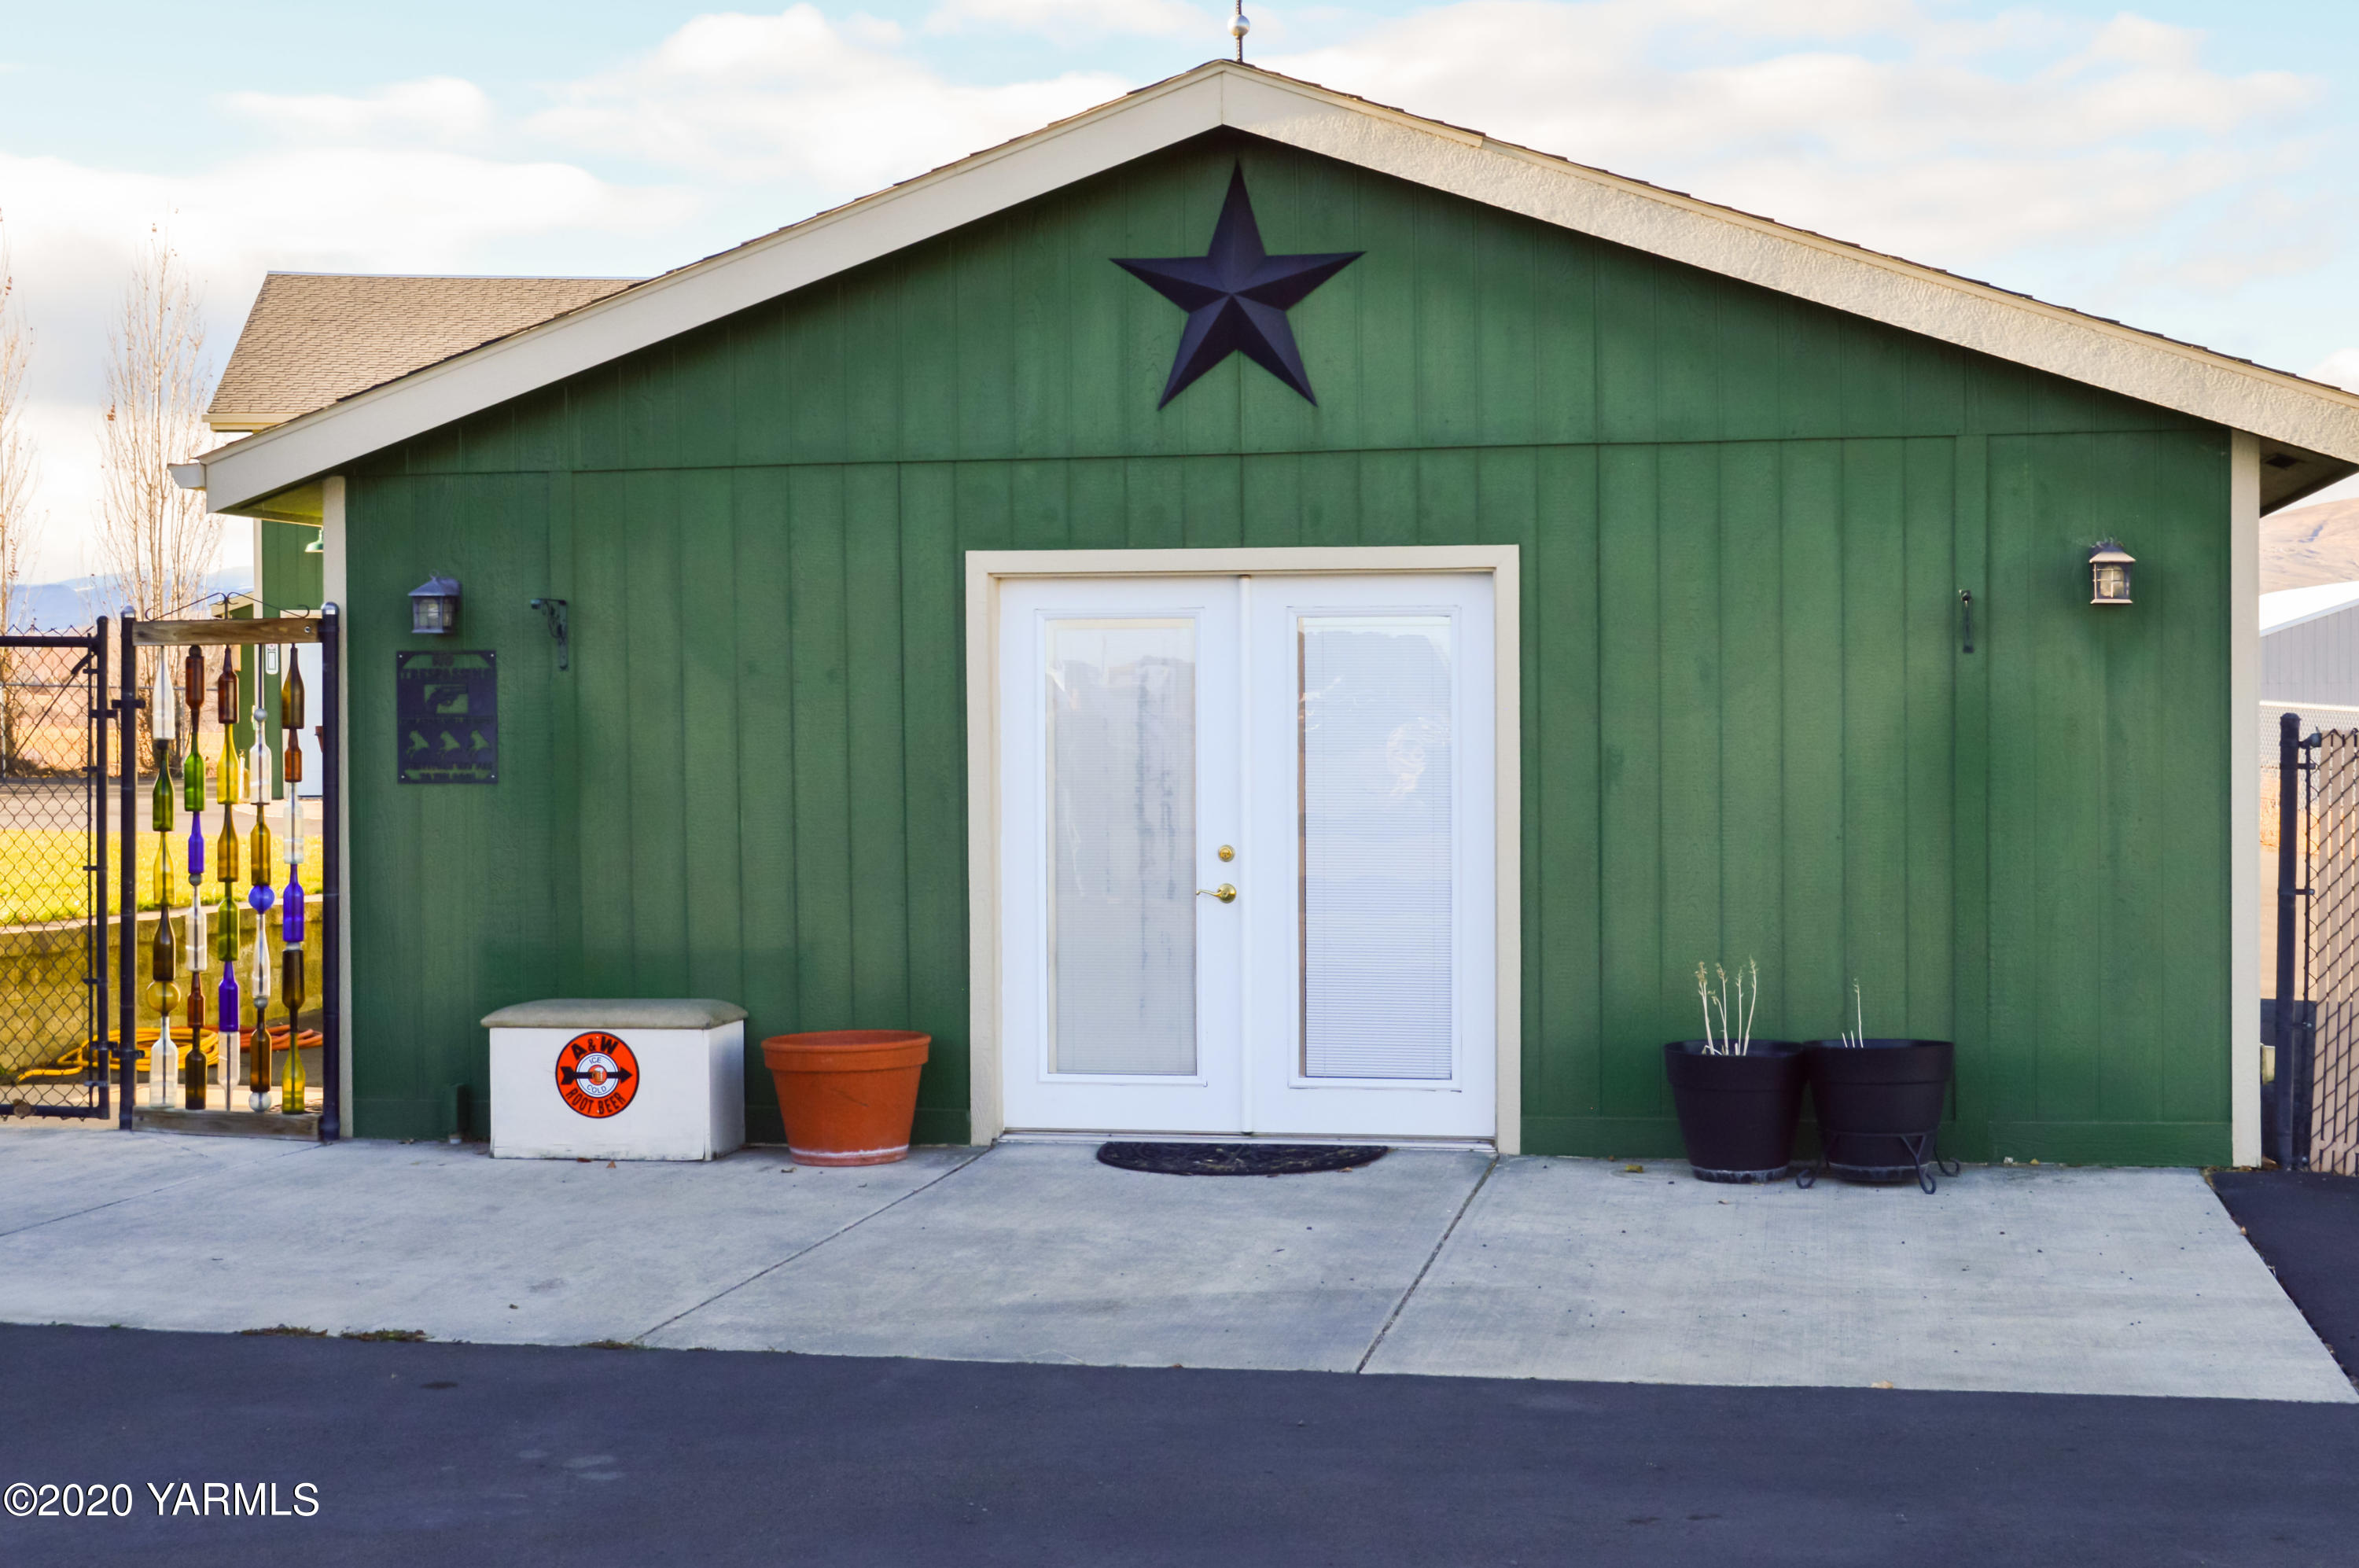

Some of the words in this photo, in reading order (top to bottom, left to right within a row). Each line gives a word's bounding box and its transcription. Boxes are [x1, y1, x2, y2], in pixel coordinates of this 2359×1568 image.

[587, 1084, 606, 1094] COLD
[565, 1088, 594, 1113] ROOT
[598, 1091, 626, 1114] BEER
